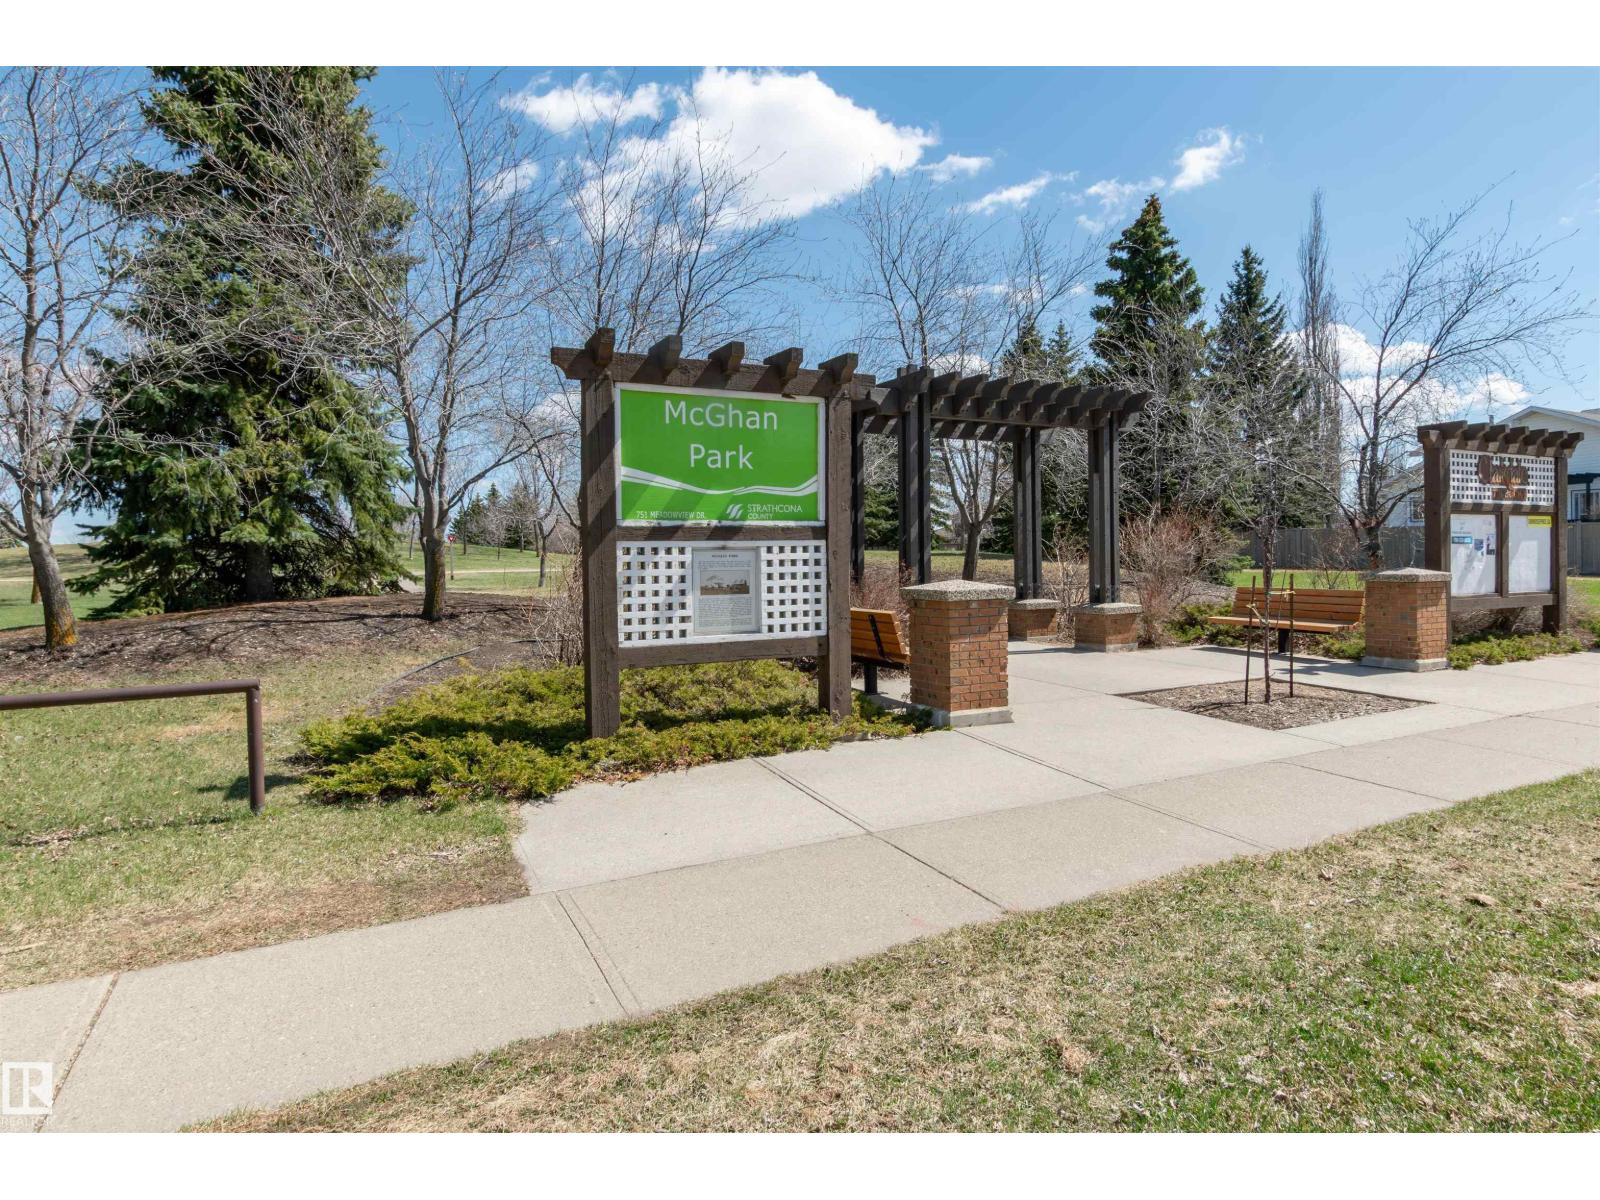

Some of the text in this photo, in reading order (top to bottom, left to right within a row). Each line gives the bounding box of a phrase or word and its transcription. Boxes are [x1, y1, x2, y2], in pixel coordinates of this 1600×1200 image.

[664, 399, 778, 431] McGhan
[690, 443, 753, 470] Park
[747, 503, 803, 513] STRATHCONA
[636, 510, 648, 519] 751
[747, 512, 774, 520] COUNTY
